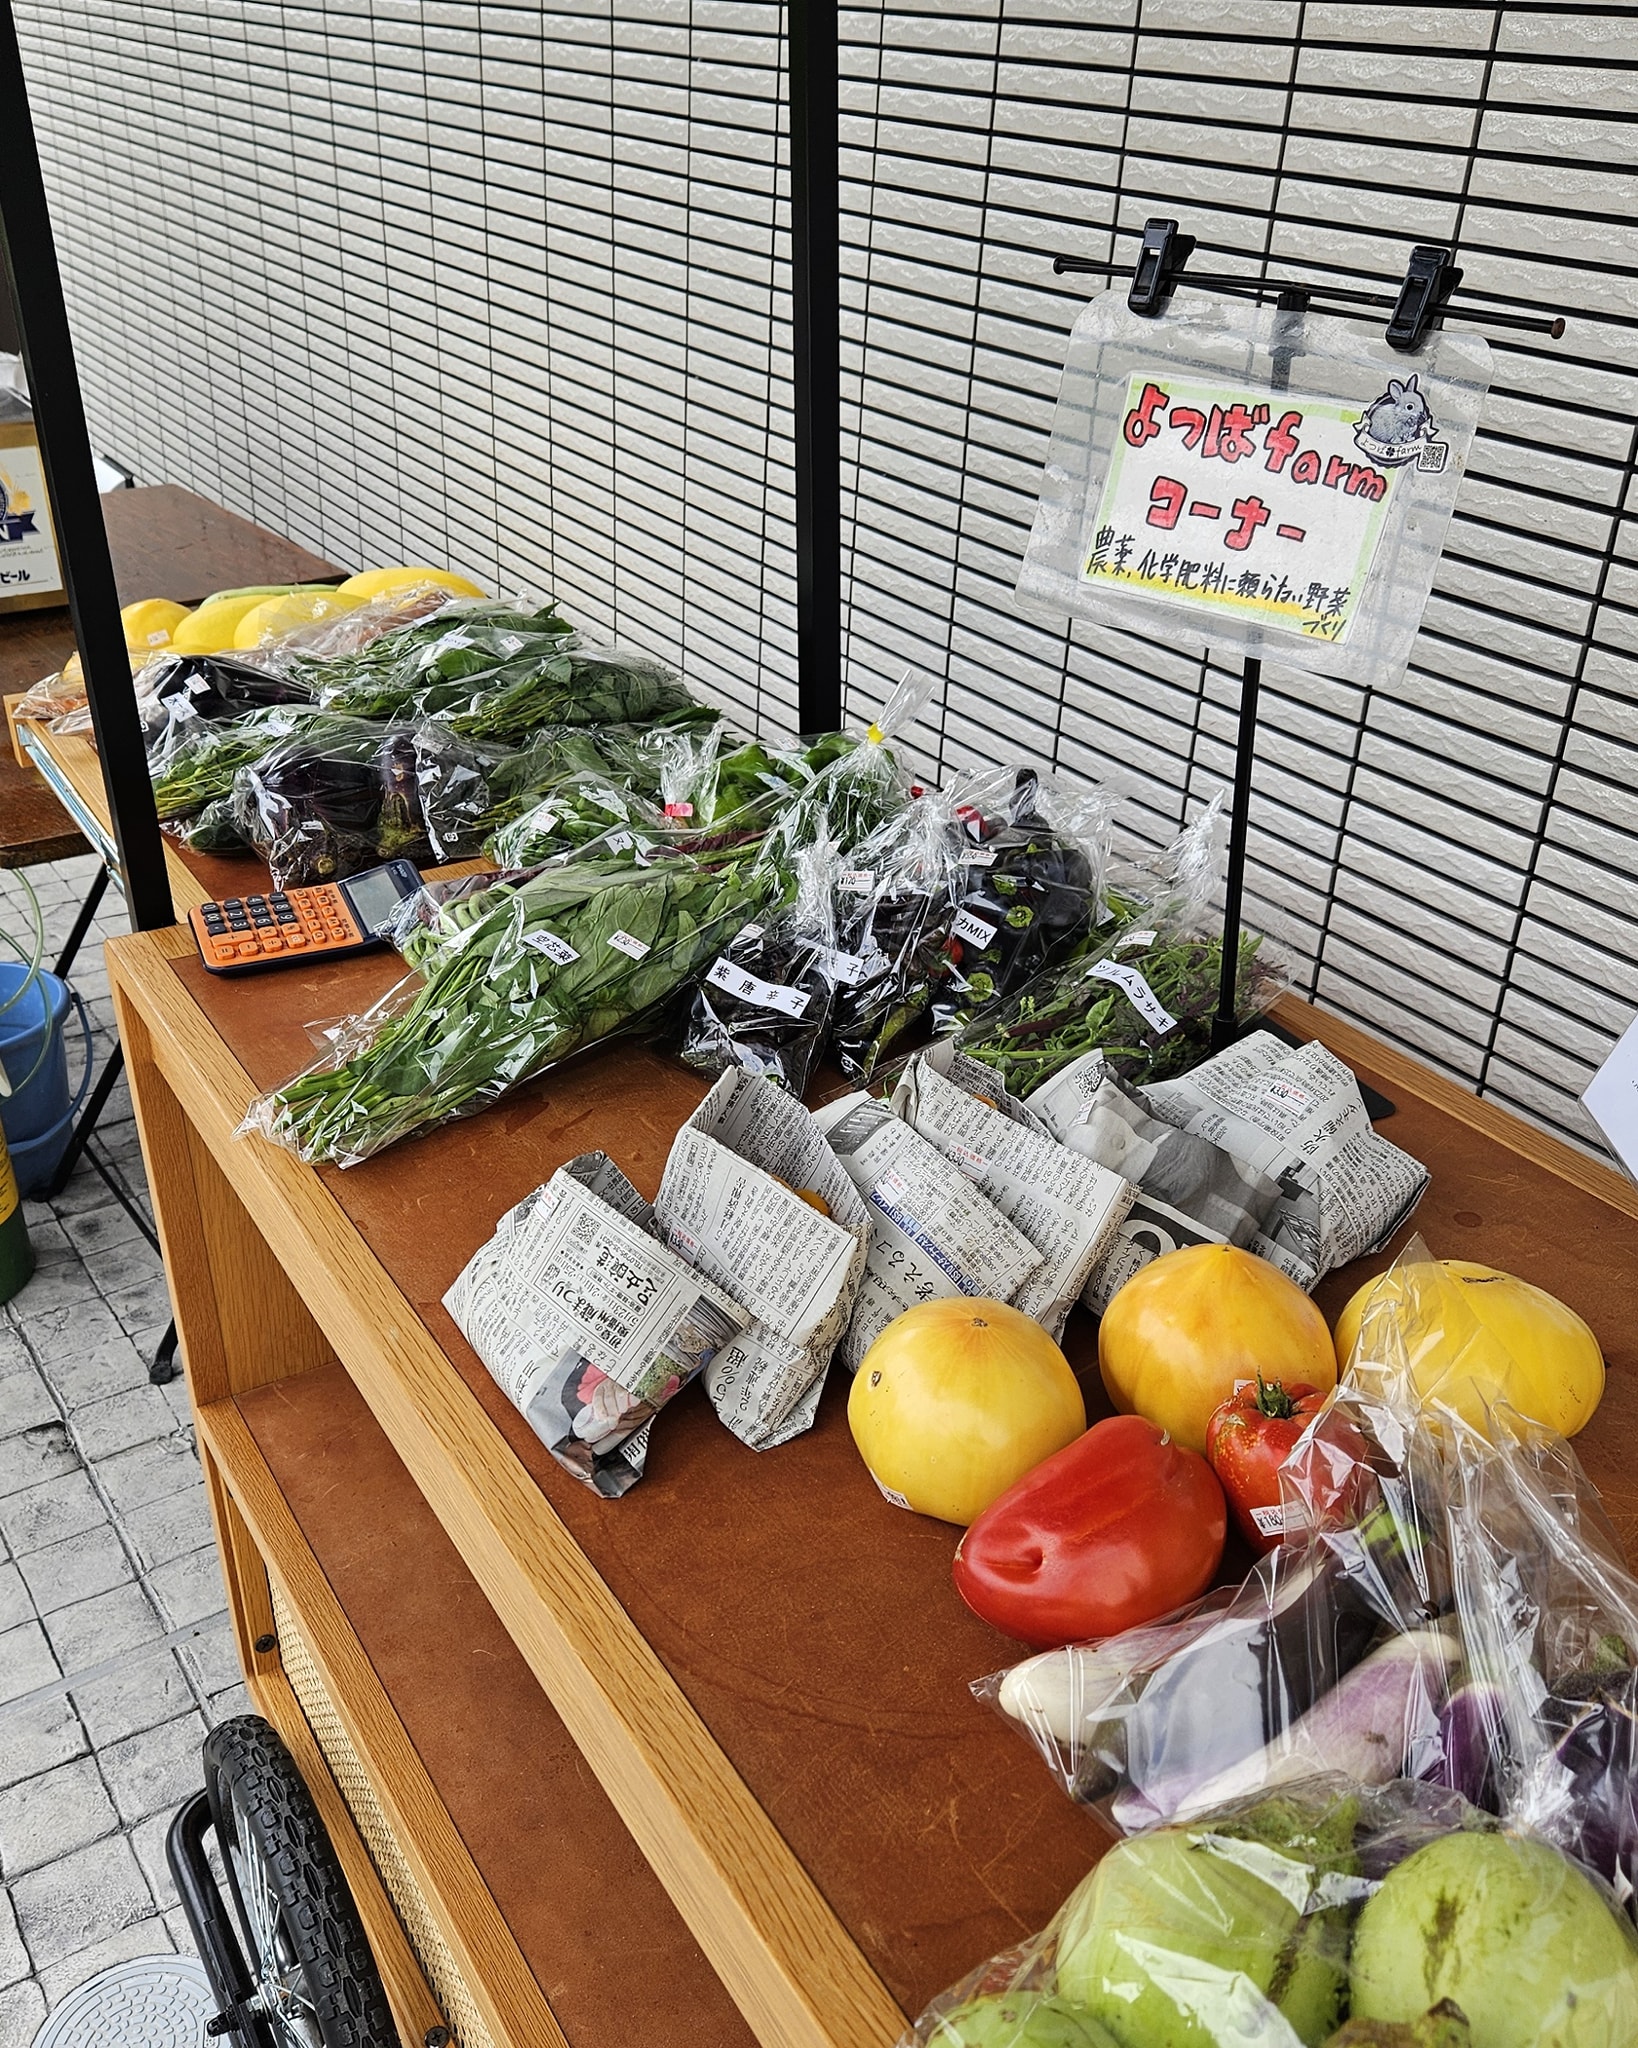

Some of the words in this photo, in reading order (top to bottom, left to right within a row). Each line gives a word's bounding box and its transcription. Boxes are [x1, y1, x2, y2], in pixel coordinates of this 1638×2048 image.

[1145, 475, 1307, 551] コーナー
[1302, 619, 1346, 641] づくり
[533, 935, 573, 962] 空芯菜
[1095, 964, 1169, 1028] ツルムラサキ
[945, 1150, 965, 1166] ¥330
[551, 1279, 598, 1322] 蔵まつり
[593, 1322, 623, 1349] 初夏の
[596, 1309, 631, 1338] 奥播州
